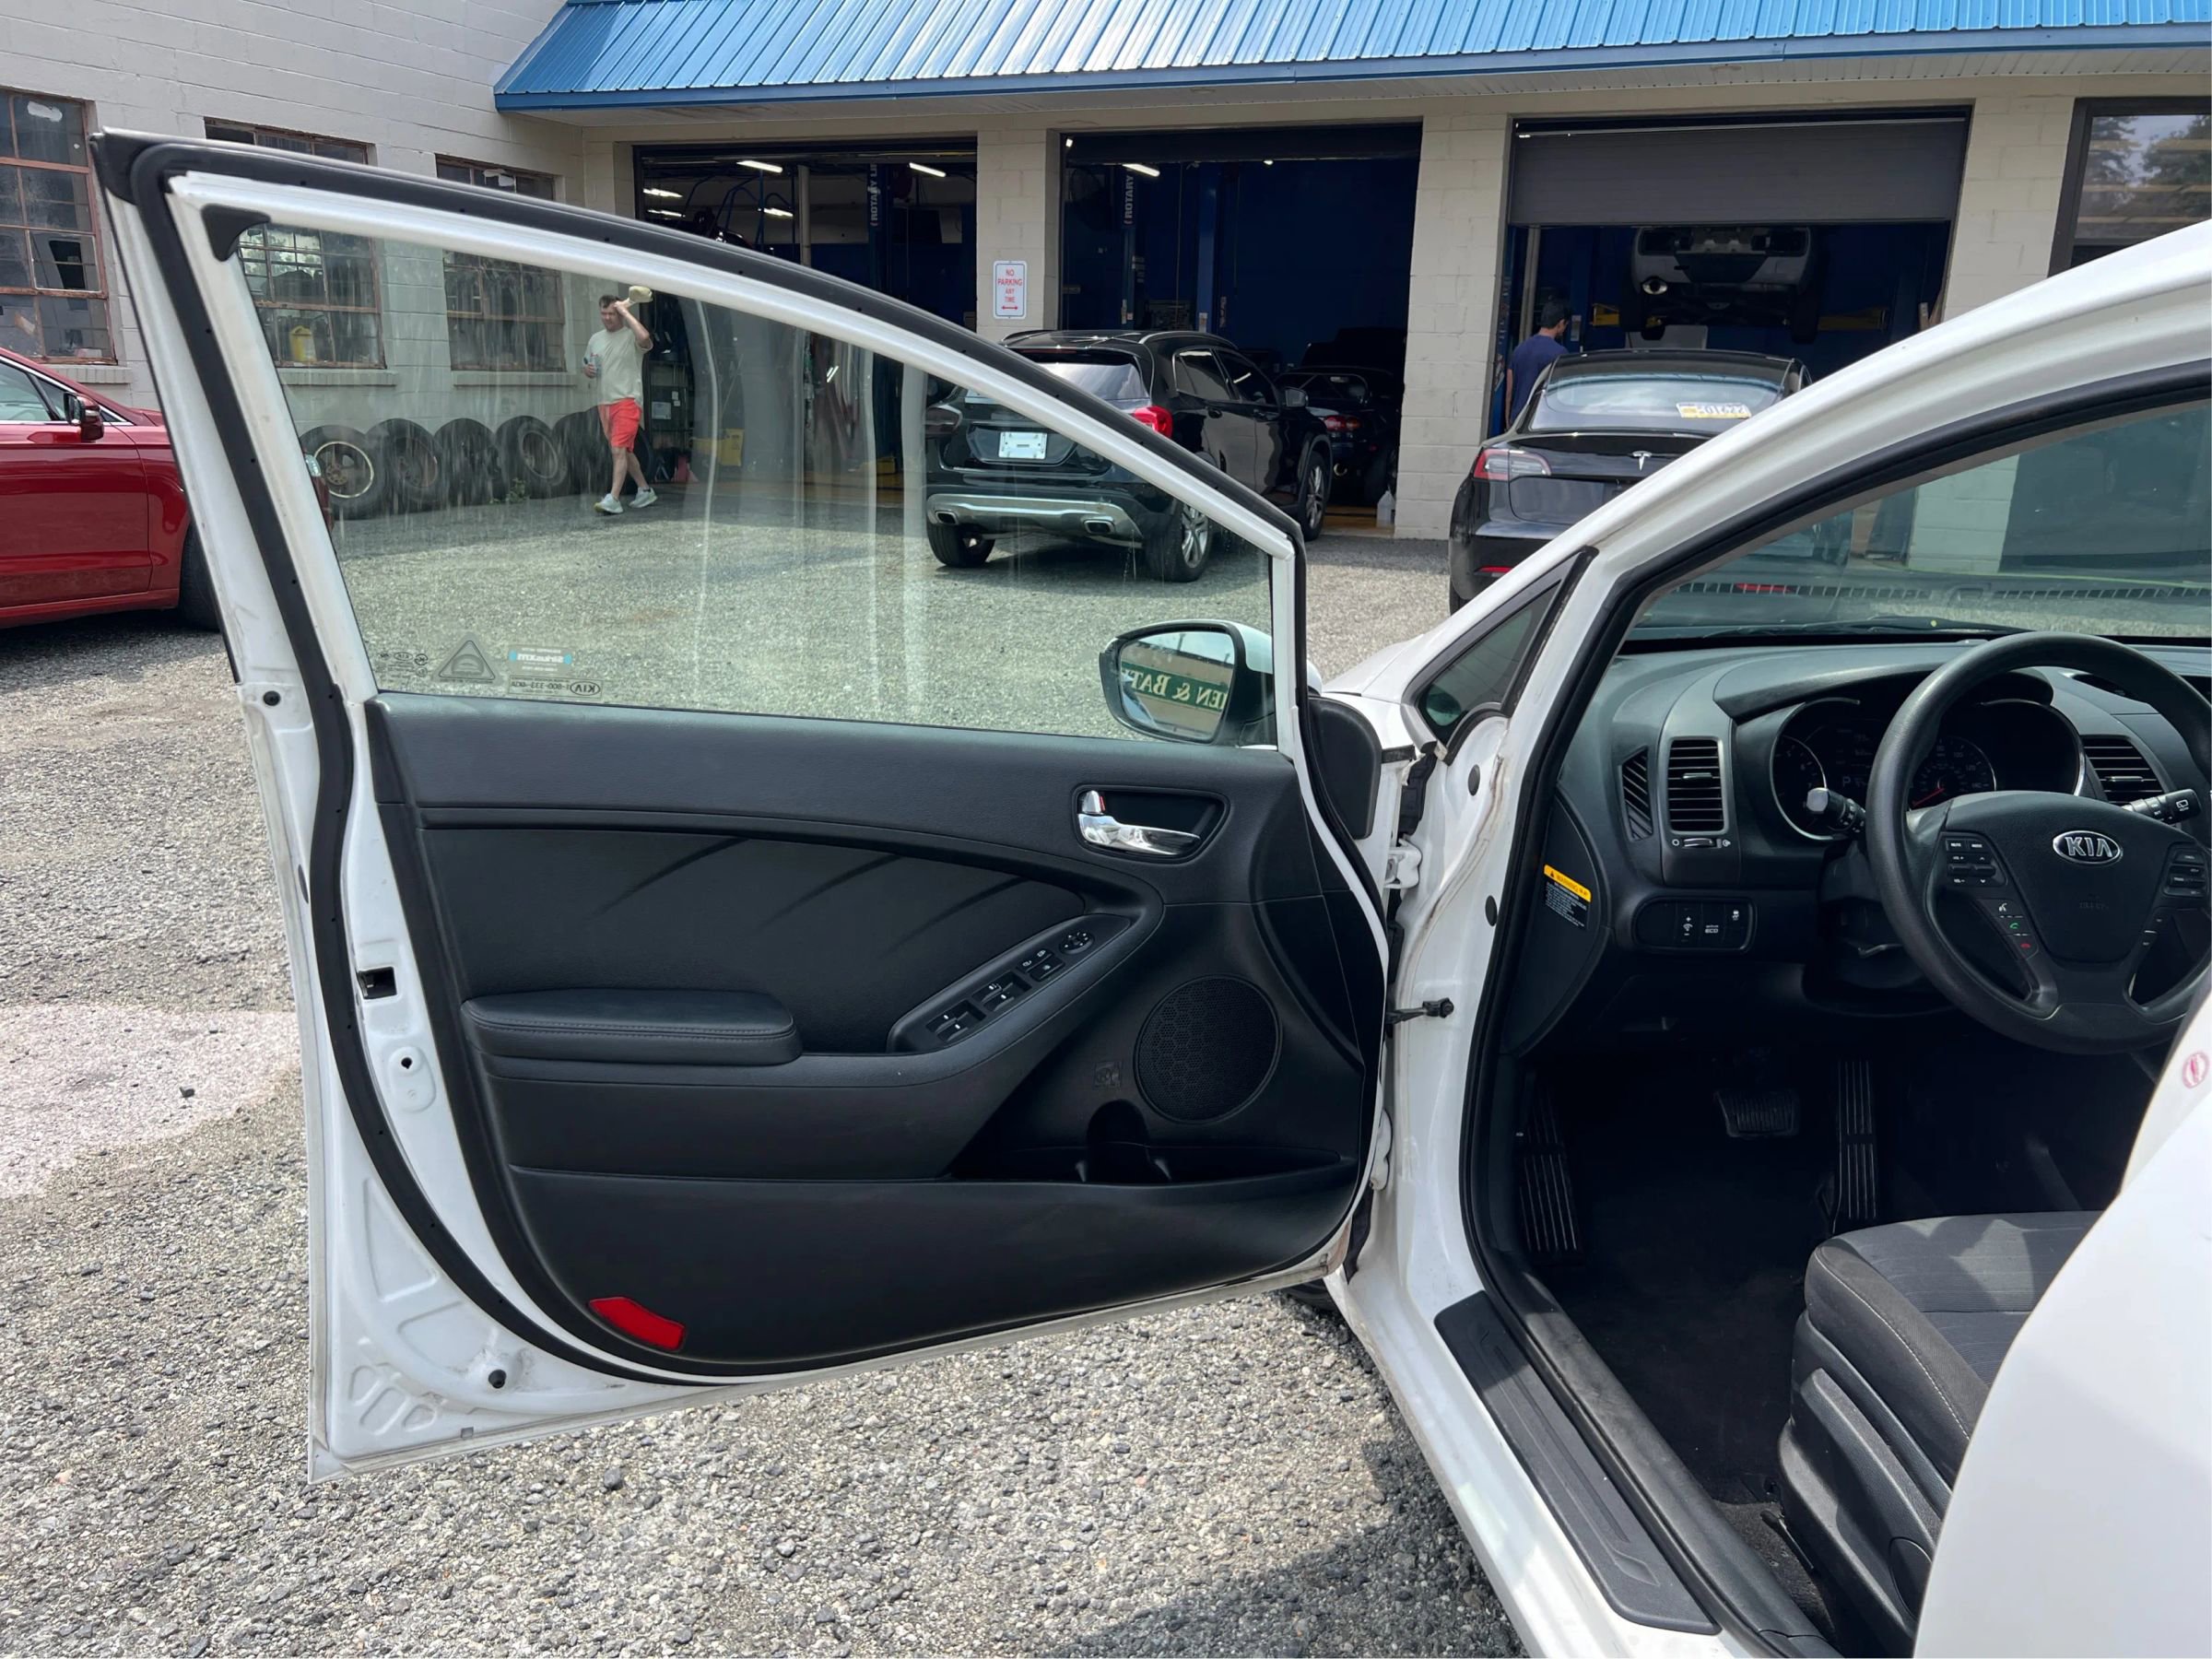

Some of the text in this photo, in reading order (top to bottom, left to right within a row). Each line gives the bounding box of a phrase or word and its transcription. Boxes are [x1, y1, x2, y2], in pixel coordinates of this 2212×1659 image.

[870, 180, 878, 221] ROTARY
[1124, 175, 1134, 219] ROTARY
[997, 278, 1023, 287] PARKING
[1006, 268, 1015, 276] NO
[2065, 836, 2113, 858] KIA
